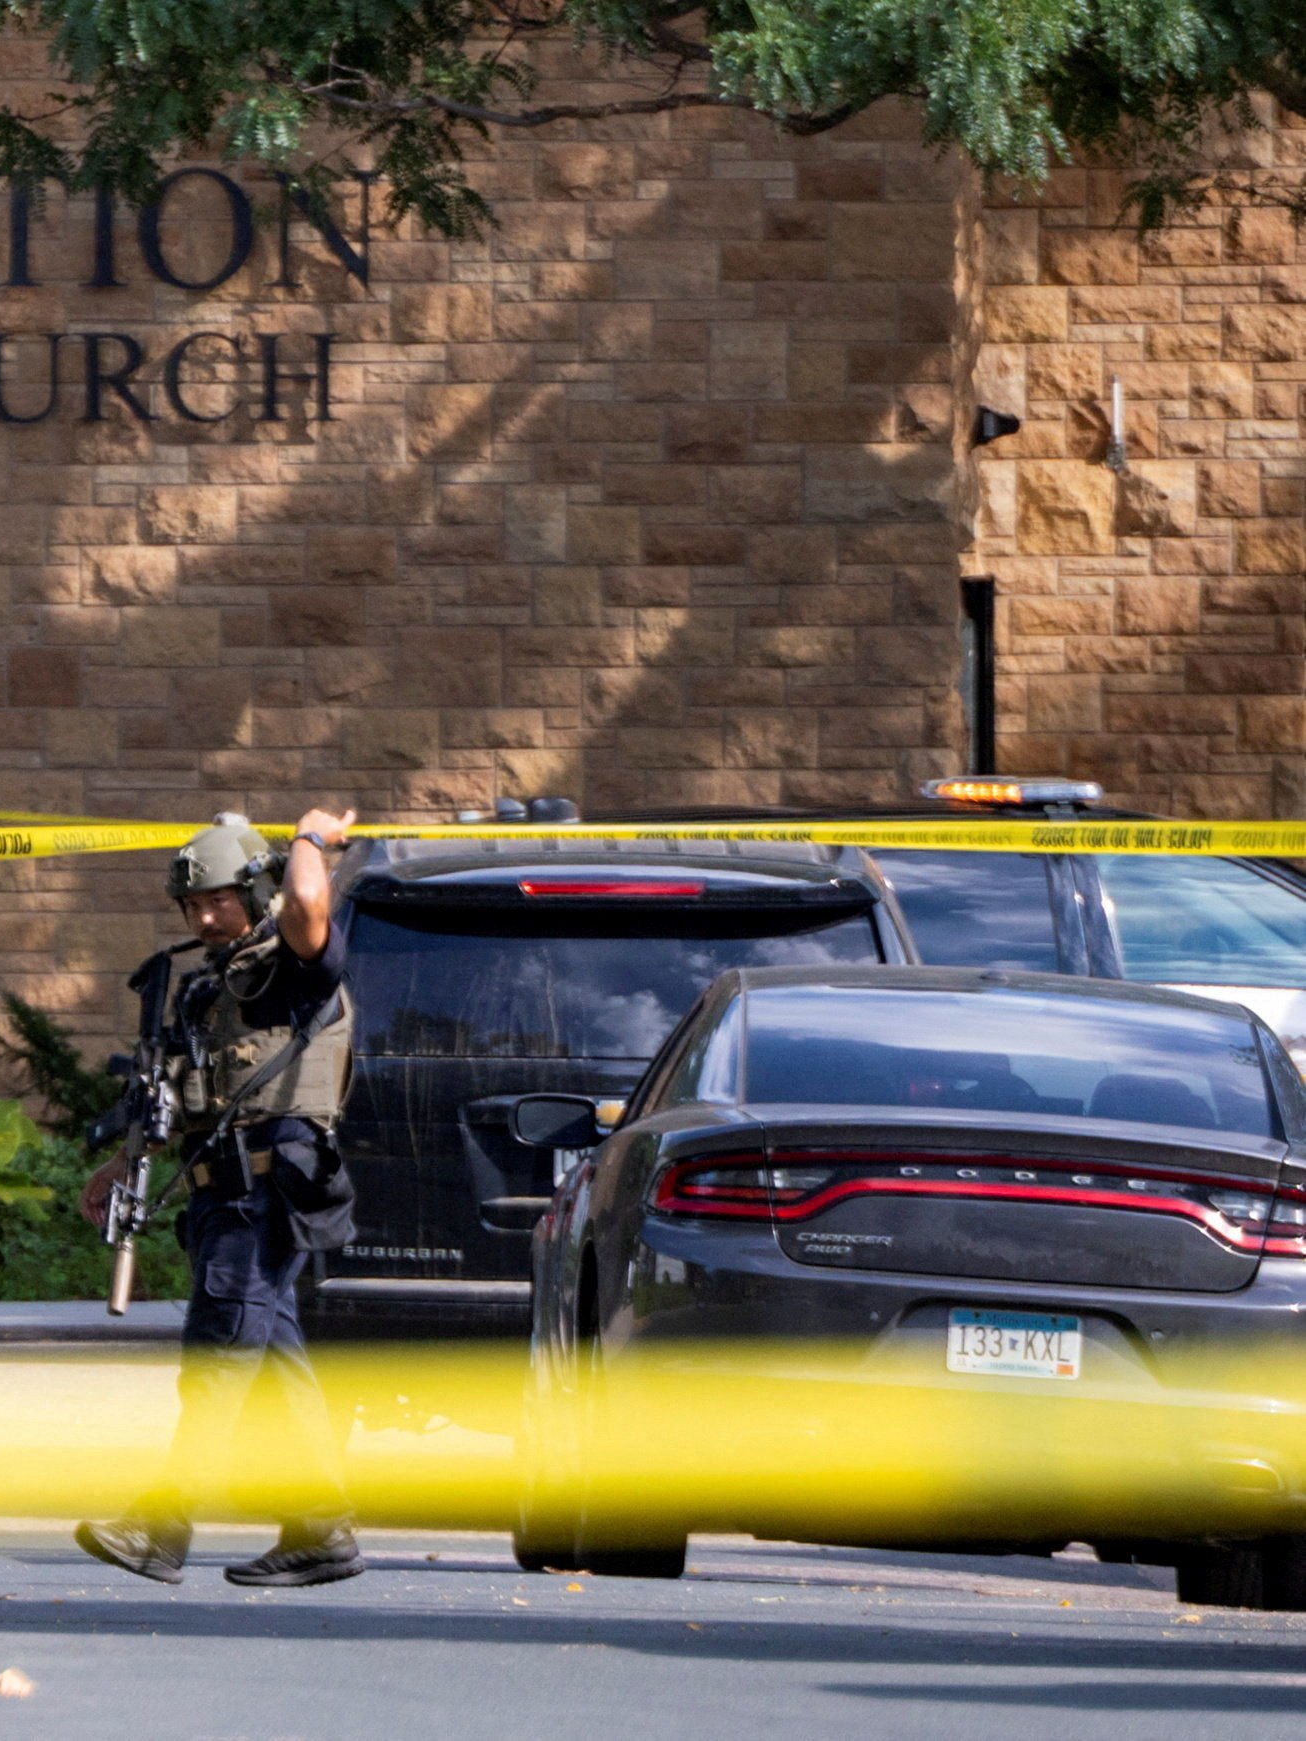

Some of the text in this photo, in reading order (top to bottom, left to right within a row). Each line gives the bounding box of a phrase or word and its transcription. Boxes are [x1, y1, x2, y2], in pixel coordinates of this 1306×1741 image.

[900, 1166, 1146, 1189] DODGE
[797, 1232, 892, 1247] CHARGER
[343, 1245, 464, 1262] SUBURBAN
[956, 1325, 1070, 1362] 133 KXL
